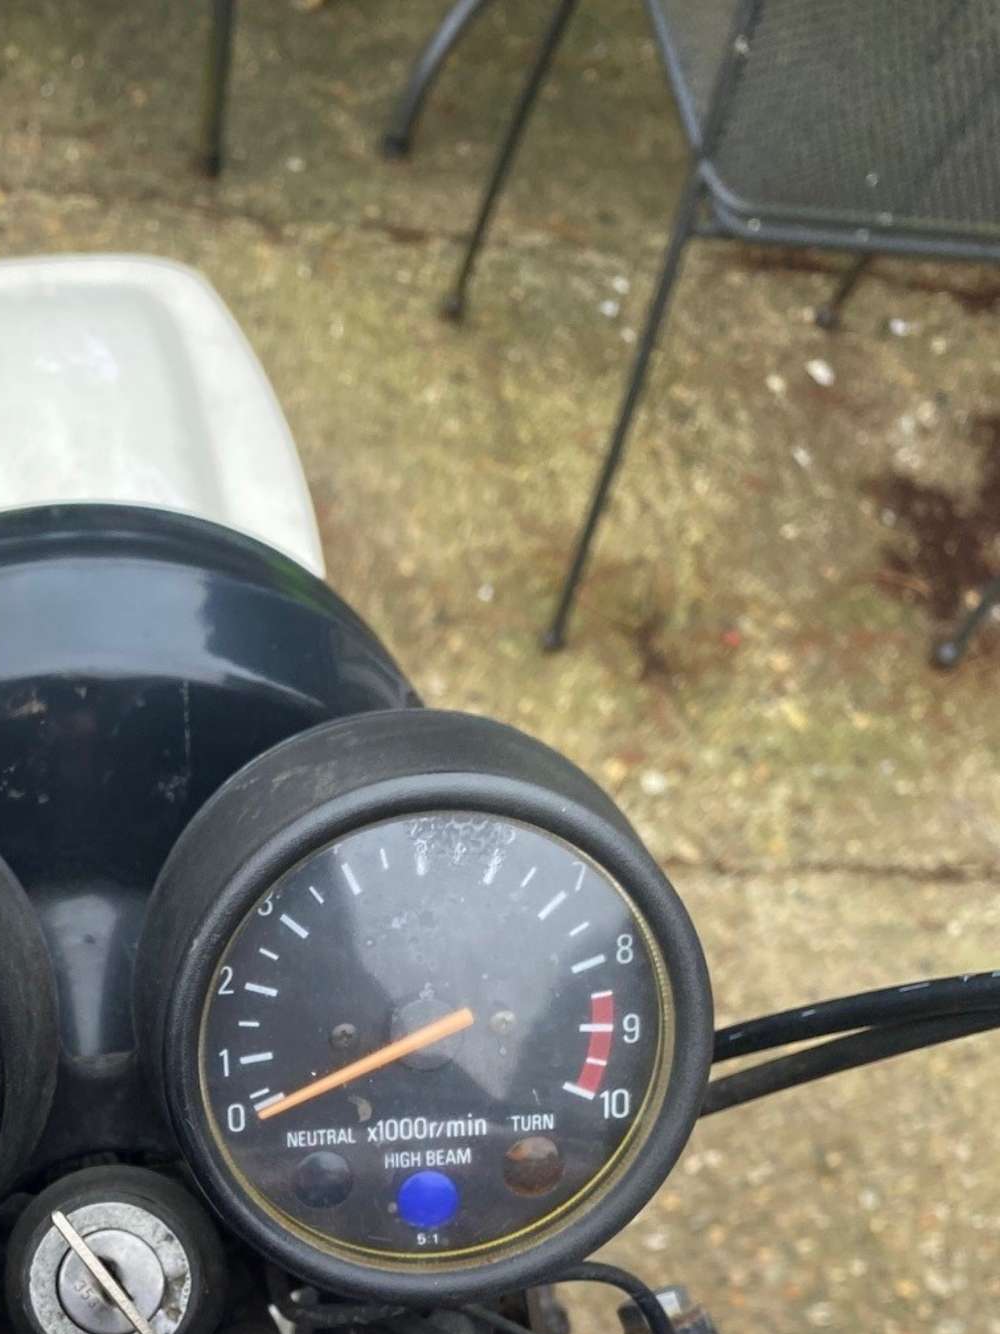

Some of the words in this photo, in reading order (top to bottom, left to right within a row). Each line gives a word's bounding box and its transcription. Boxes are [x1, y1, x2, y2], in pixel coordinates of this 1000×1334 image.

[616, 933, 634, 964] 8
[217, 966, 235, 995] 2
[622, 1013, 641, 1043] 9
[218, 1048, 230, 1078] 1
[227, 1103, 246, 1132] 0
[600, 1088, 631, 1120] 10
[286, 1127, 357, 1148] NEUTRAL
[366, 1113, 488, 1143] x1000r/min
[511, 1114, 555, 1132] TURN
[384, 1150, 421, 1169] HIGH
[425, 1148, 472, 1167] BEAM
